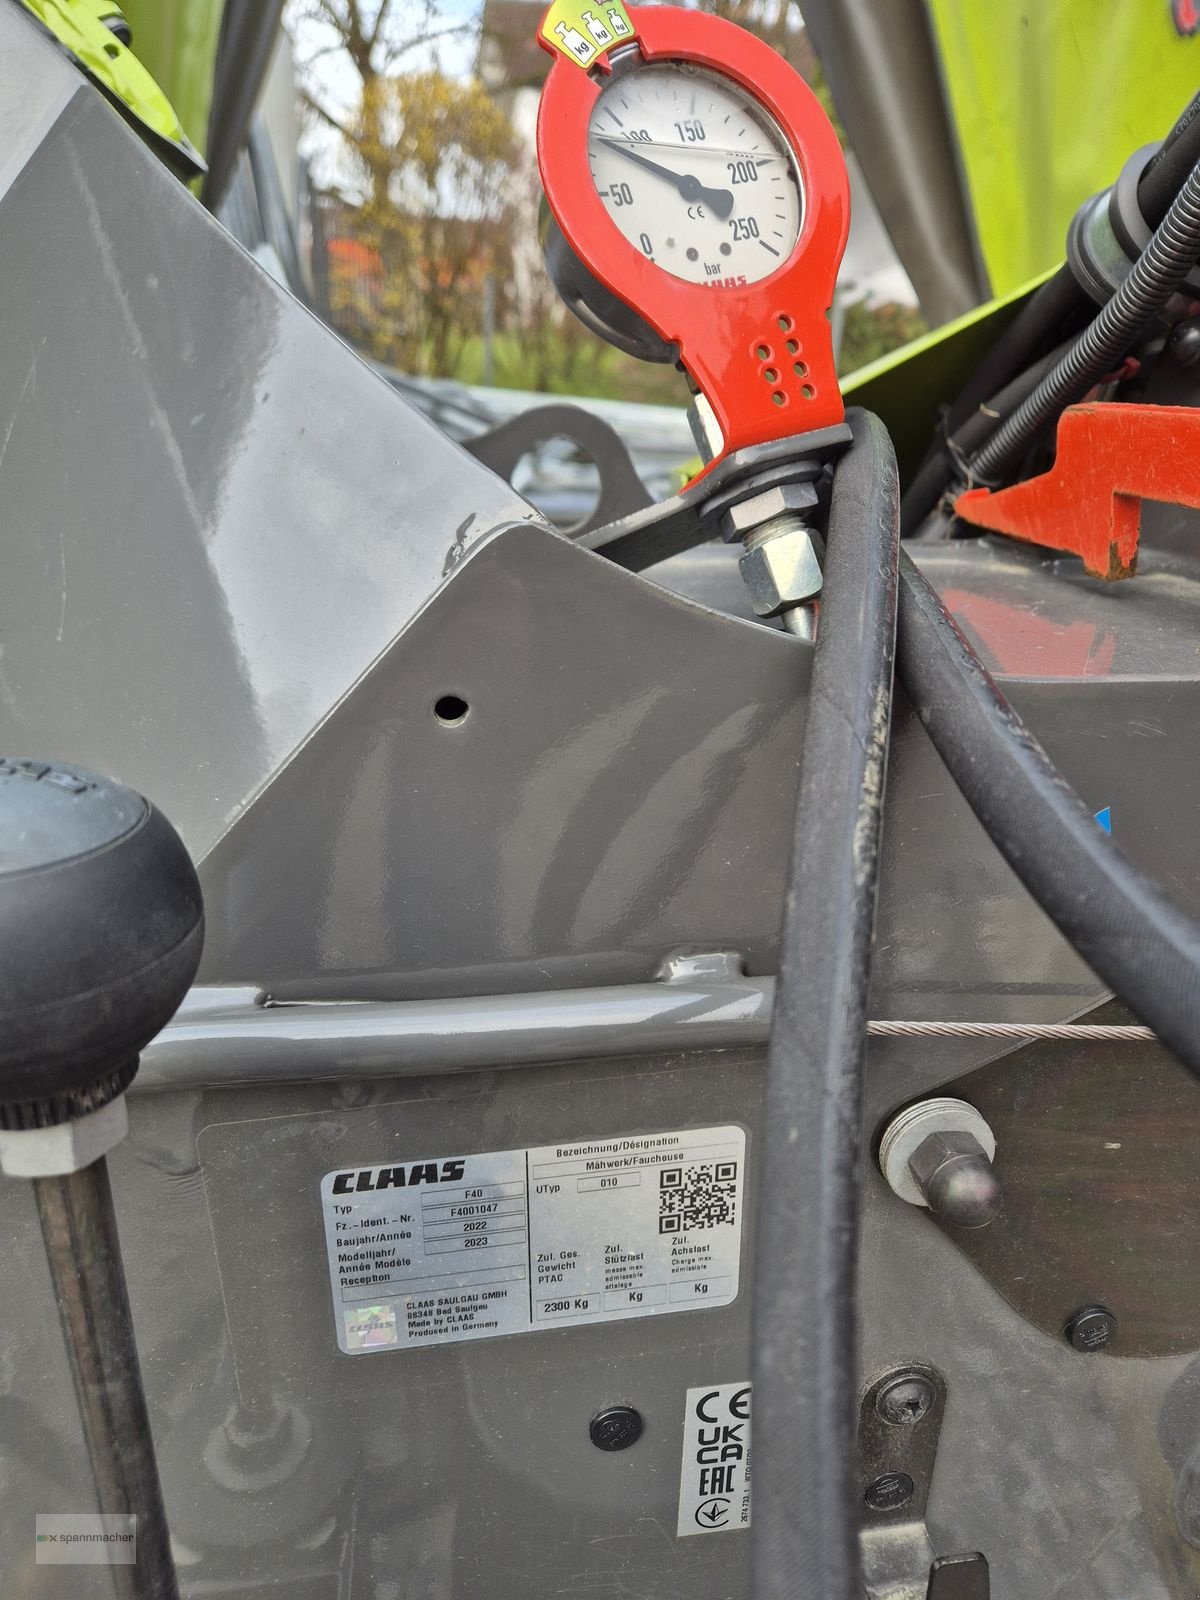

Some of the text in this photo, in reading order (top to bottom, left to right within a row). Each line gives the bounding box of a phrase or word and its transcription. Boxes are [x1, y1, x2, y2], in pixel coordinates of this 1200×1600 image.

[595, 30, 609, 40] kg
[574, 41, 590, 55] kg
[674, 118, 706, 143] 150
[727, 160, 759, 185] 200
[610, 182, 634, 207] 50
[728, 216, 761, 242] 250
[639, 232, 653, 256] 0
[703, 262, 721, 276] bar
[556, 1135, 680, 1158] Bezeichnung/Désignation
[586, 1152, 685, 1171] Mähwerk/Faucheuse
[331, 1159, 466, 1195] CLAAS
[600, 1177, 618, 1188] 010
[464, 1188, 483, 1200] F40
[536, 1183, 561, 1195] UTyp
[333, 1204, 353, 1215] Typ
[450, 1203, 498, 1218] F4001047
[463, 1221, 488, 1232] 2022
[336, 1230, 412, 1248] Baujahr/Année
[464, 1237, 488, 1248] 2023
[672, 1236, 690, 1246] Zul.
[338, 1248, 396, 1263] Modelljahr/
[537, 1249, 581, 1262] Zul. Ges.
[604, 1244, 623, 1254] Zul.
[671, 1244, 710, 1257] Achslast
[604, 1252, 644, 1265] Stützlast
[338, 1258, 412, 1274] Année Modèle
[537, 1261, 576, 1273] Gewicht
[340, 1273, 391, 1287] Reception
[538, 1273, 564, 1284] PTAC
[694, 1283, 708, 1294] Kg
[406, 1290, 508, 1310] CLAAS SAULGAU GMBH
[629, 1291, 643, 1302] Kg
[436, 1306, 452, 1316] Bad
[455, 1303, 488, 1313] Saulgau
[544, 1299, 588, 1313] 2300 Kg
[408, 1313, 475, 1329] Made by CLAAS
[408, 1326, 449, 1338] Produced
[462, 1321, 498, 1331] Germany
[697, 1423, 745, 1446] UK
[696, 1443, 744, 1465] CA
